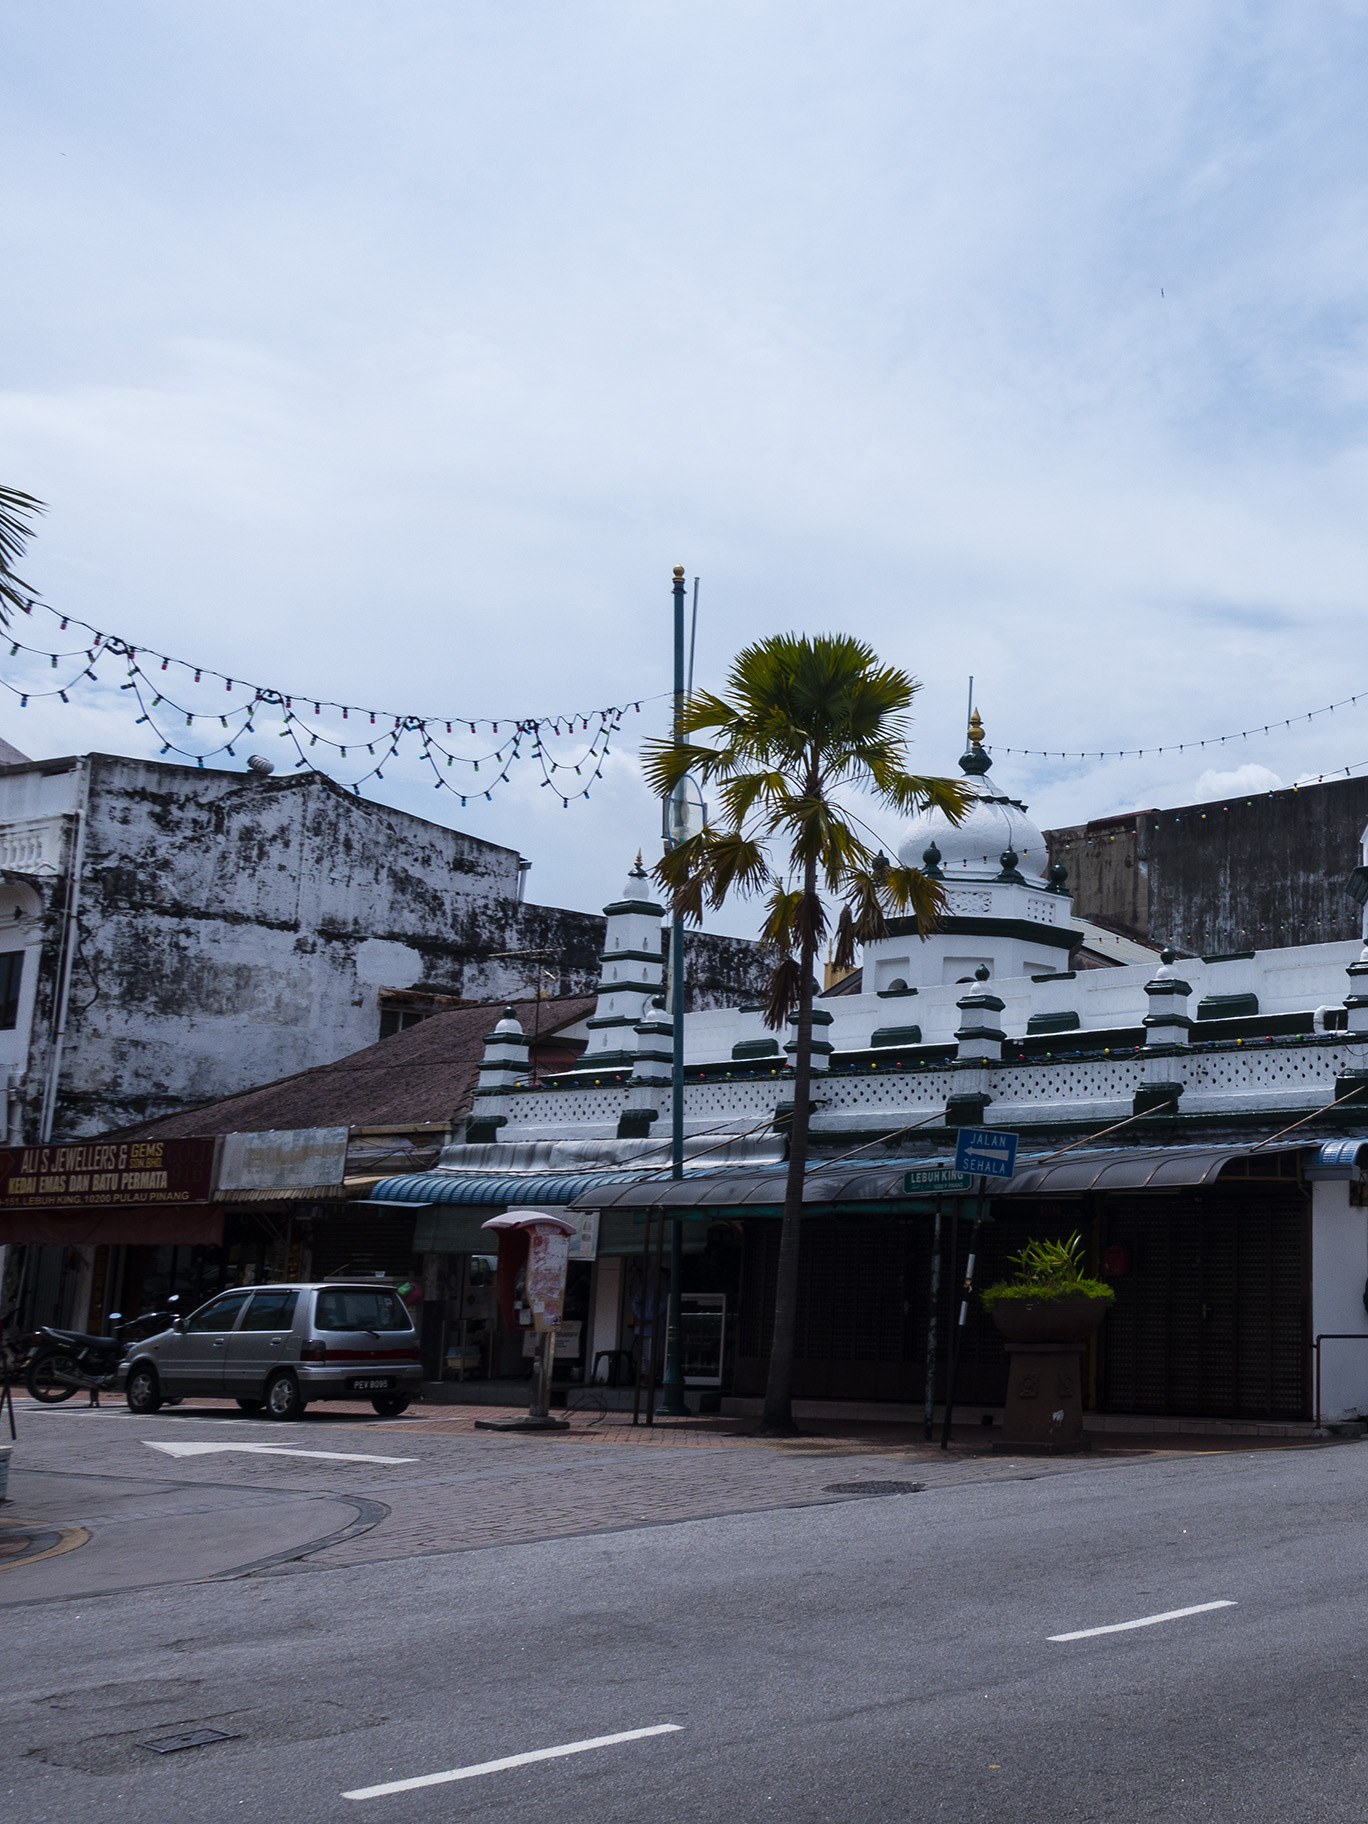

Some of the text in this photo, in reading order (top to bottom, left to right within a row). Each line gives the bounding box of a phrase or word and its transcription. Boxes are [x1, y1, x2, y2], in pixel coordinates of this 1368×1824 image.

[969, 1132, 1007, 1148] JALAN
[130, 1142, 164, 1158] GEMS
[50, 1144, 117, 1173] JEWELLERS
[118, 1144, 128, 1169] &
[962, 1158, 1006, 1174] SEHALA
[7, 1170, 168, 1195] KEDAI EMAS DAN BATU PERMATA
[911, 1170, 964, 1184] LEBUH KING
[23, 1195, 56, 1206] LEBUH
[84, 1193, 112, 1203] 10200
[112, 1191, 148, 1202] PULAU
[149, 1191, 190, 1201] PINANG
